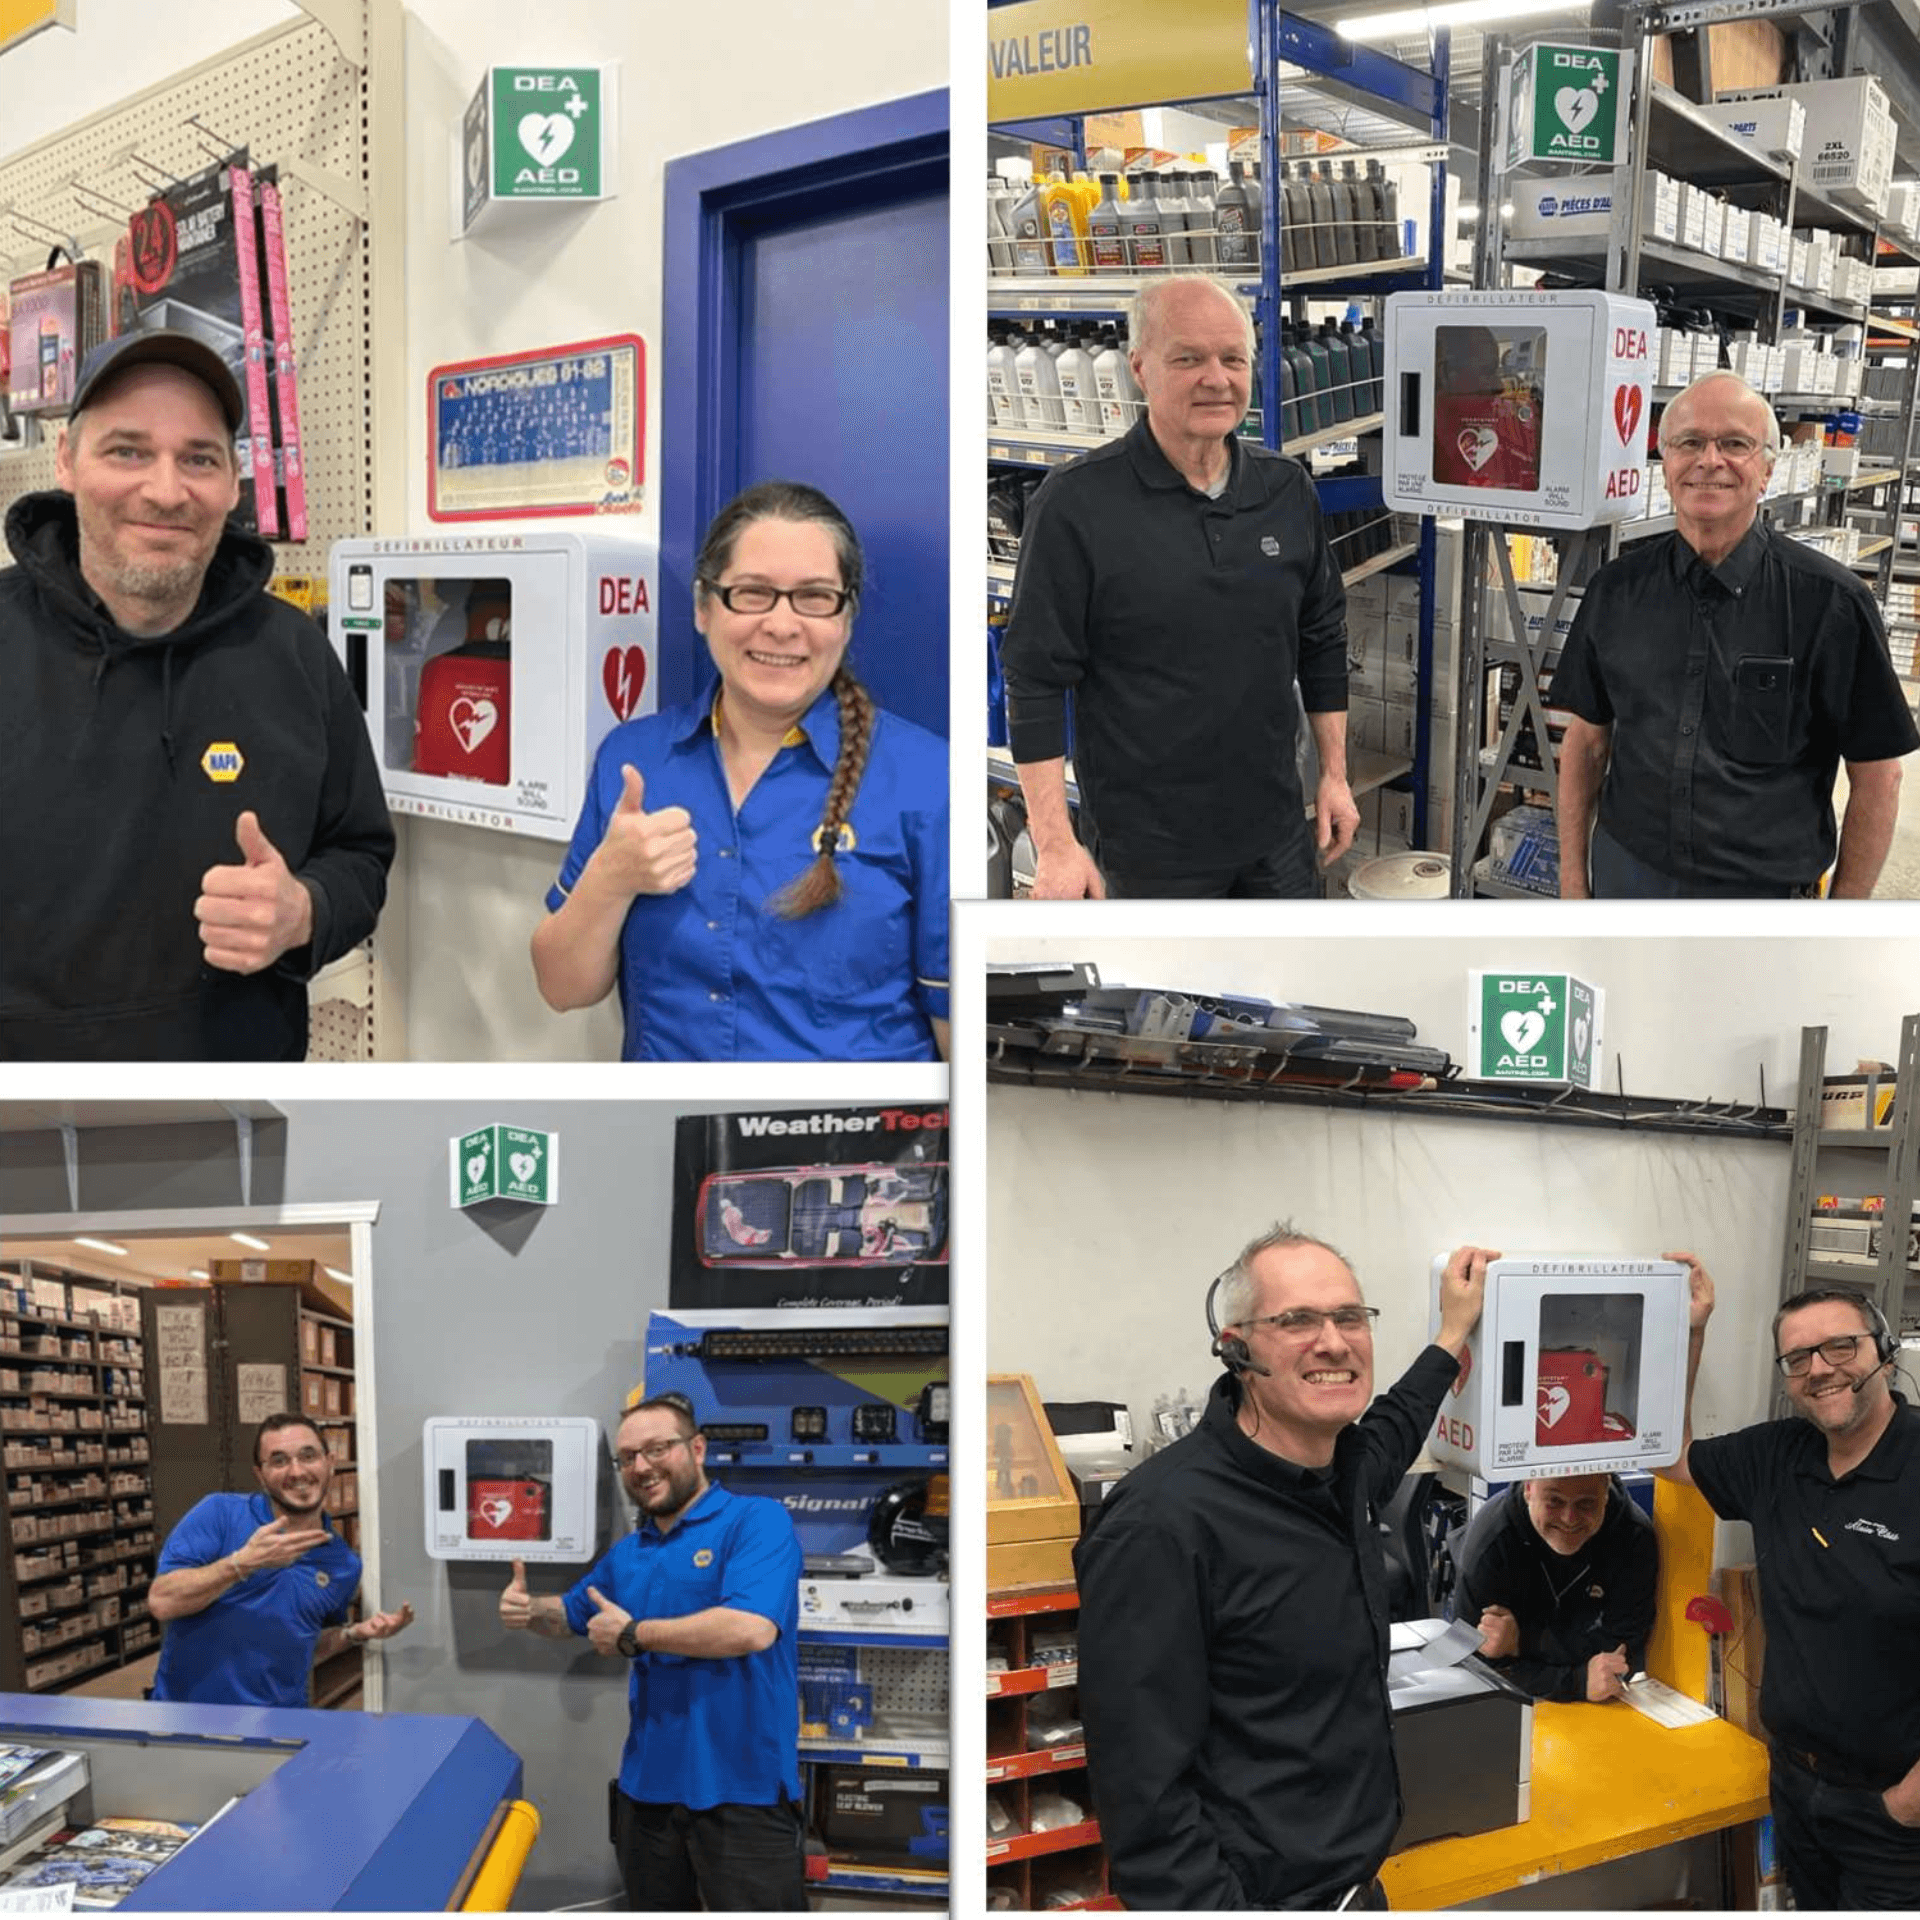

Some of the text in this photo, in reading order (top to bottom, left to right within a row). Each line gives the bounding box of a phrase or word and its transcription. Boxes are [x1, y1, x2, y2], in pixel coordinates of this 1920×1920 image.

[987, 24, 1092, 79] VALEUR
[1553, 53, 1604, 71] DEA
[514, 75, 579, 91] DEA
[1550, 133, 1600, 150] AED
[1825, 142, 1845, 151] 2XL
[1817, 151, 1850, 161] 66520
[514, 168, 580, 184] AED
[1616, 328, 1647, 360] DEA
[1606, 469, 1640, 499] AED
[600, 576, 649, 615] DEA
[388, 797, 513, 828] EFIBRILLATOR
[1499, 981, 1550, 994] DEA
[1497, 1054, 1548, 1068] AED
[1437, 1415, 1473, 1451] AED
[783, 1494, 869, 1512] Signal
